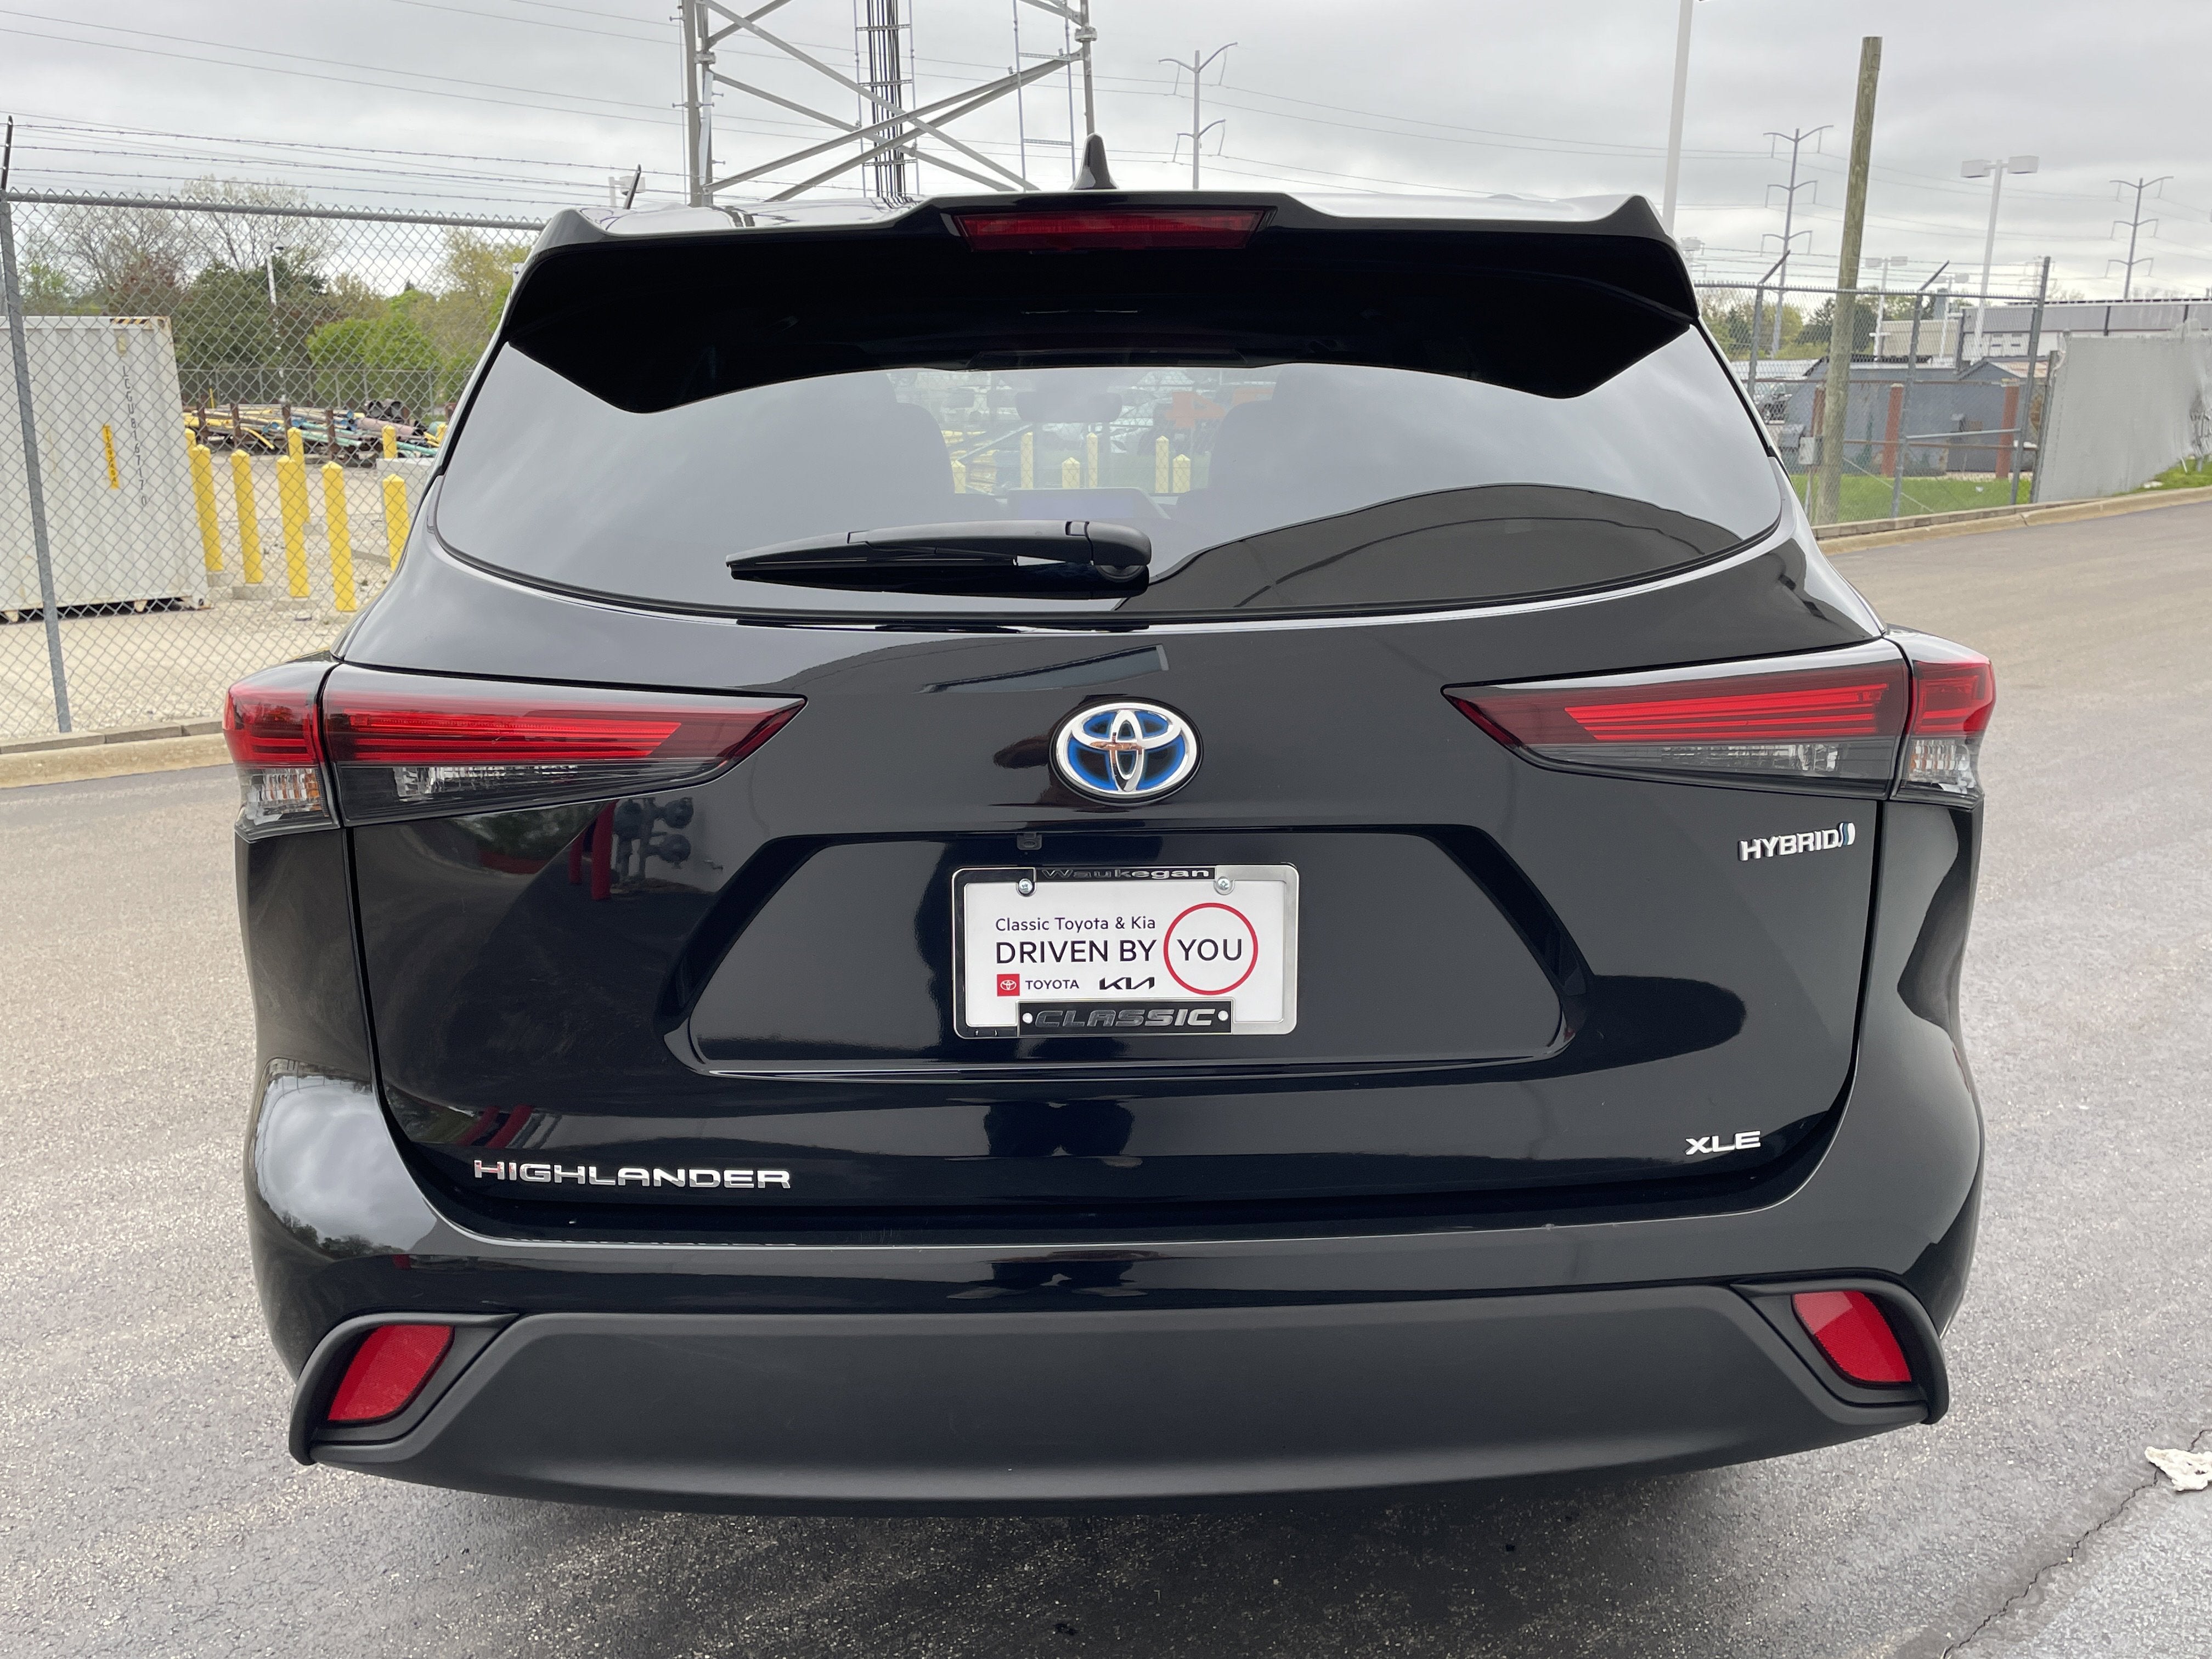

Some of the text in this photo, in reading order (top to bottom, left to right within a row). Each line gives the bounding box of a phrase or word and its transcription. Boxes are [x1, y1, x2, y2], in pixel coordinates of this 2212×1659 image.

[1739, 829, 1839, 861] HYBRID
[1042, 869, 1210, 879] Waukegan
[995, 916, 1155, 933] Classic Toyota & Kia
[996, 939, 1242, 964] DRIVEN BY YOU
[1025, 979, 1080, 990] TOYOTA
[1035, 1008, 1216, 1028] CLASSIC
[1685, 1130, 1761, 1155] XLE
[473, 1159, 791, 1189] HIGHLANDER
